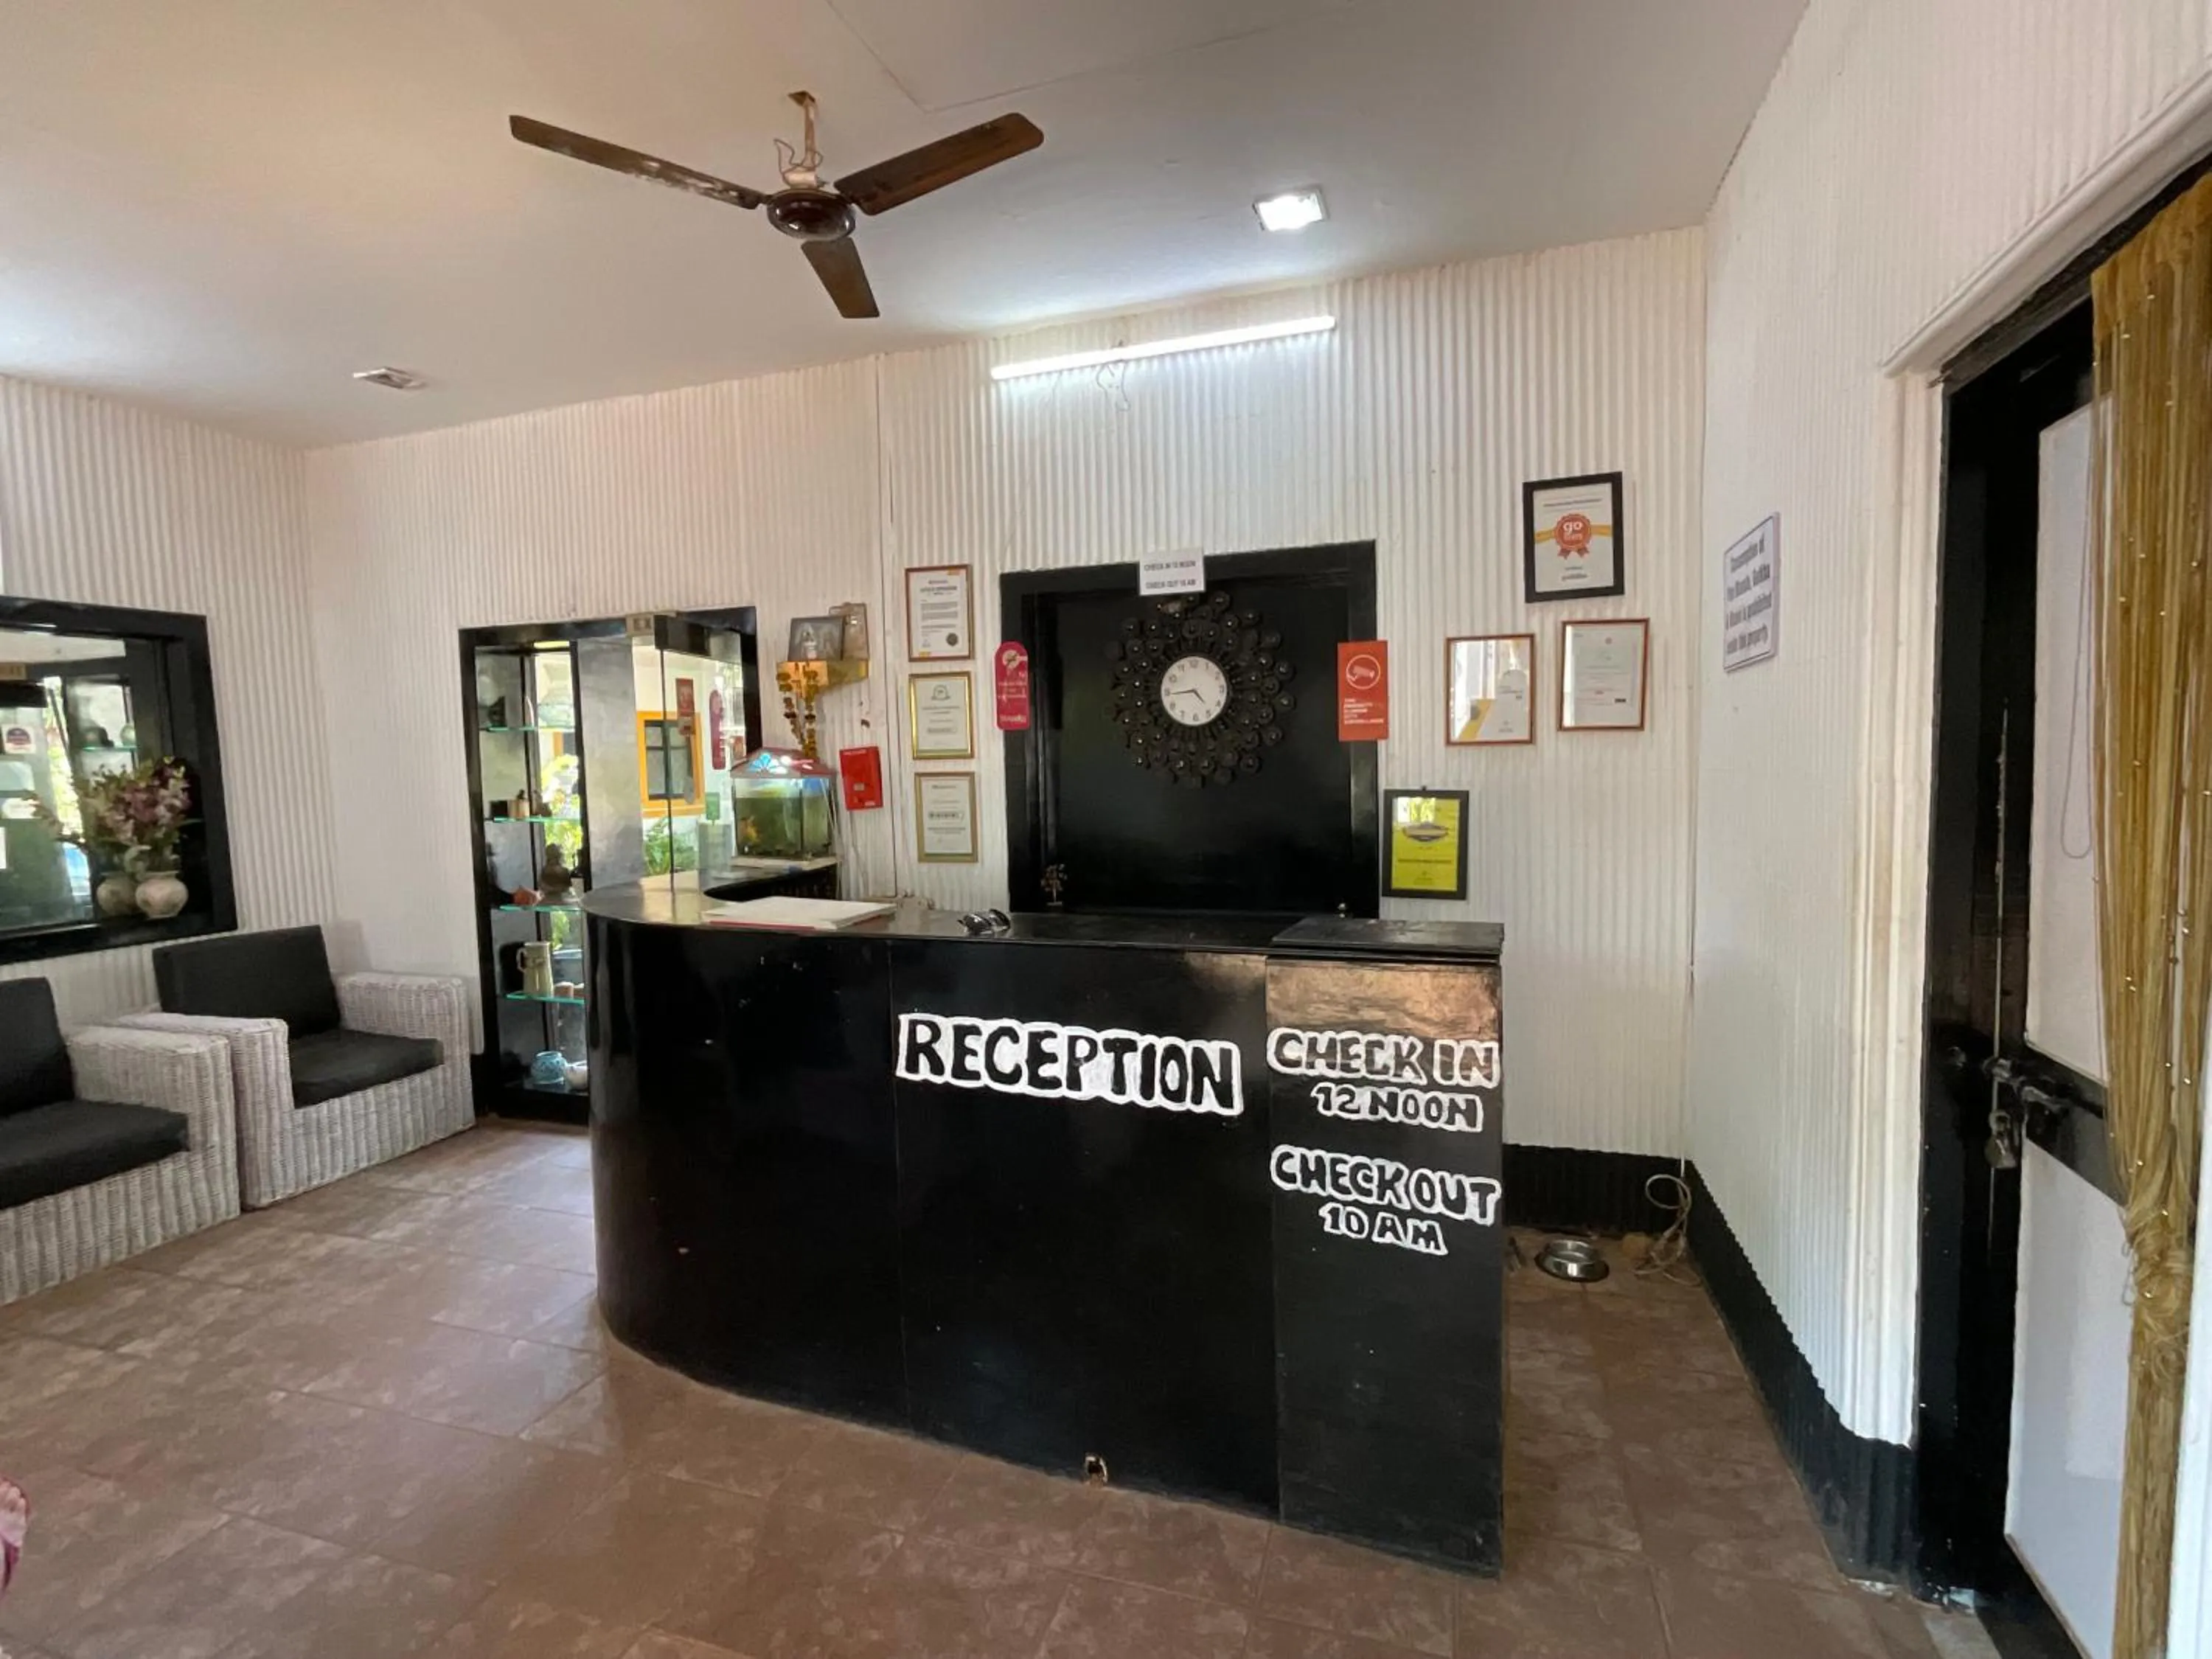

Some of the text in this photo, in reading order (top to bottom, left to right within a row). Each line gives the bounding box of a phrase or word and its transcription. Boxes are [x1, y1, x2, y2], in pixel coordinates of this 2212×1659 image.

[899, 1015, 1240, 1113] RECEPTION
[1270, 1029, 1498, 1087] CHECK IN
[1313, 1084, 1481, 1130] 12 NOON
[1322, 1206, 1445, 1253] 10 AM
